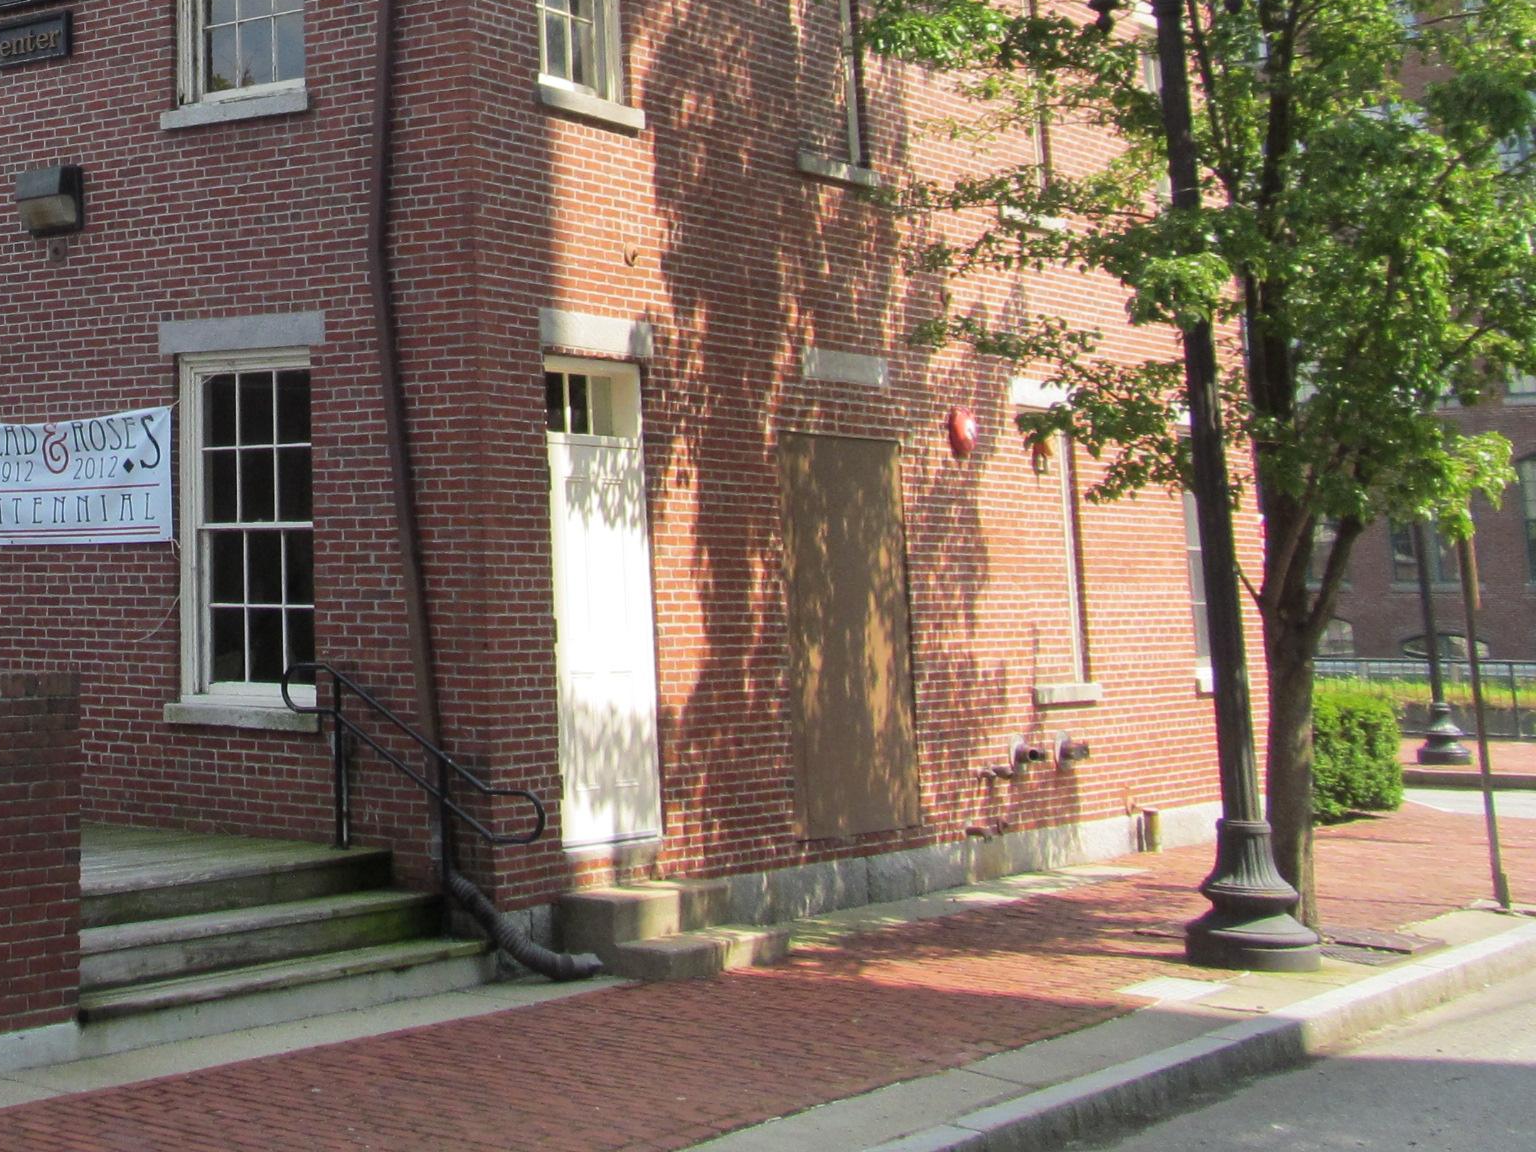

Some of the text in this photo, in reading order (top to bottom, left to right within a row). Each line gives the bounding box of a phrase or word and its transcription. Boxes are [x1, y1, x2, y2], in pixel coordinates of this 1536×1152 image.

[41, 422, 70, 474] &
[70, 414, 161, 469] ROSES
[73, 456, 118, 480] 2012
